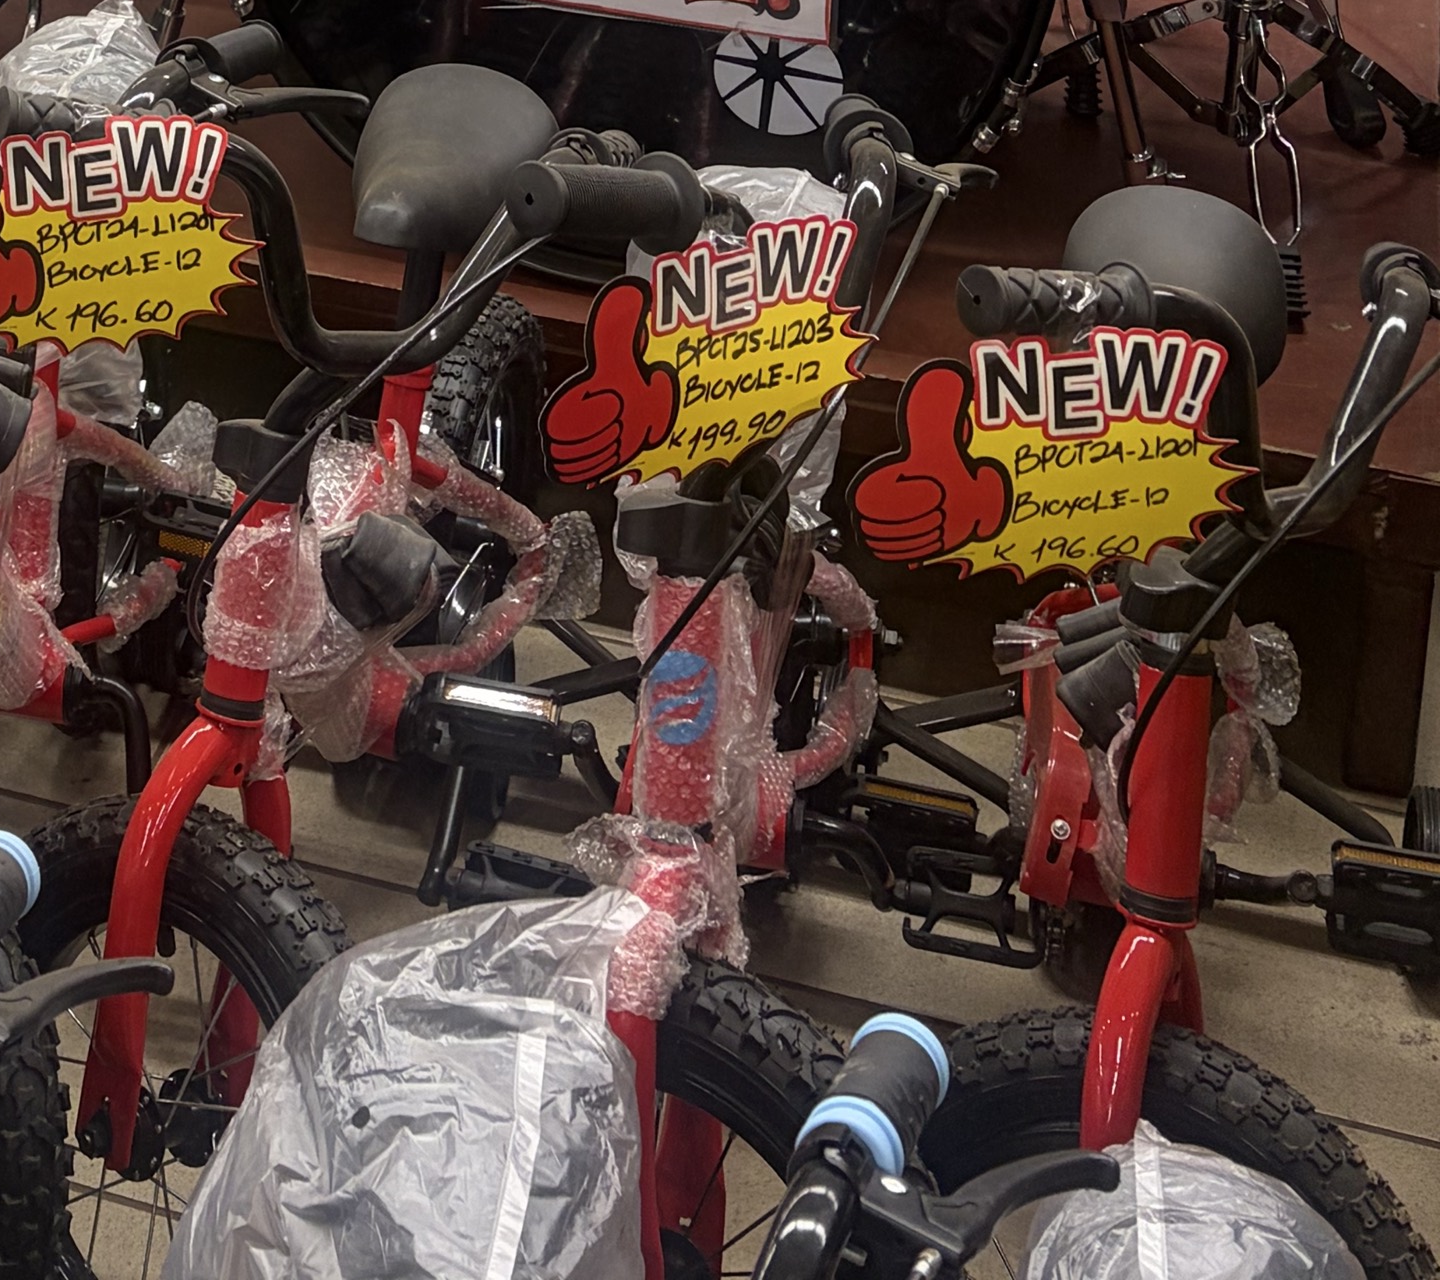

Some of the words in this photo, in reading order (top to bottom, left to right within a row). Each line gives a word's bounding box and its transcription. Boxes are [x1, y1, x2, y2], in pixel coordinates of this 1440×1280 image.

[8, 123, 221, 217] NEW!
[657, 223, 852, 331] NEW!
[65, 299, 173, 333] 196.60
[978, 334, 1219, 435] NEW!
[687, 409, 786, 460] 199.90
[1031, 535, 1139, 564] 196.60
